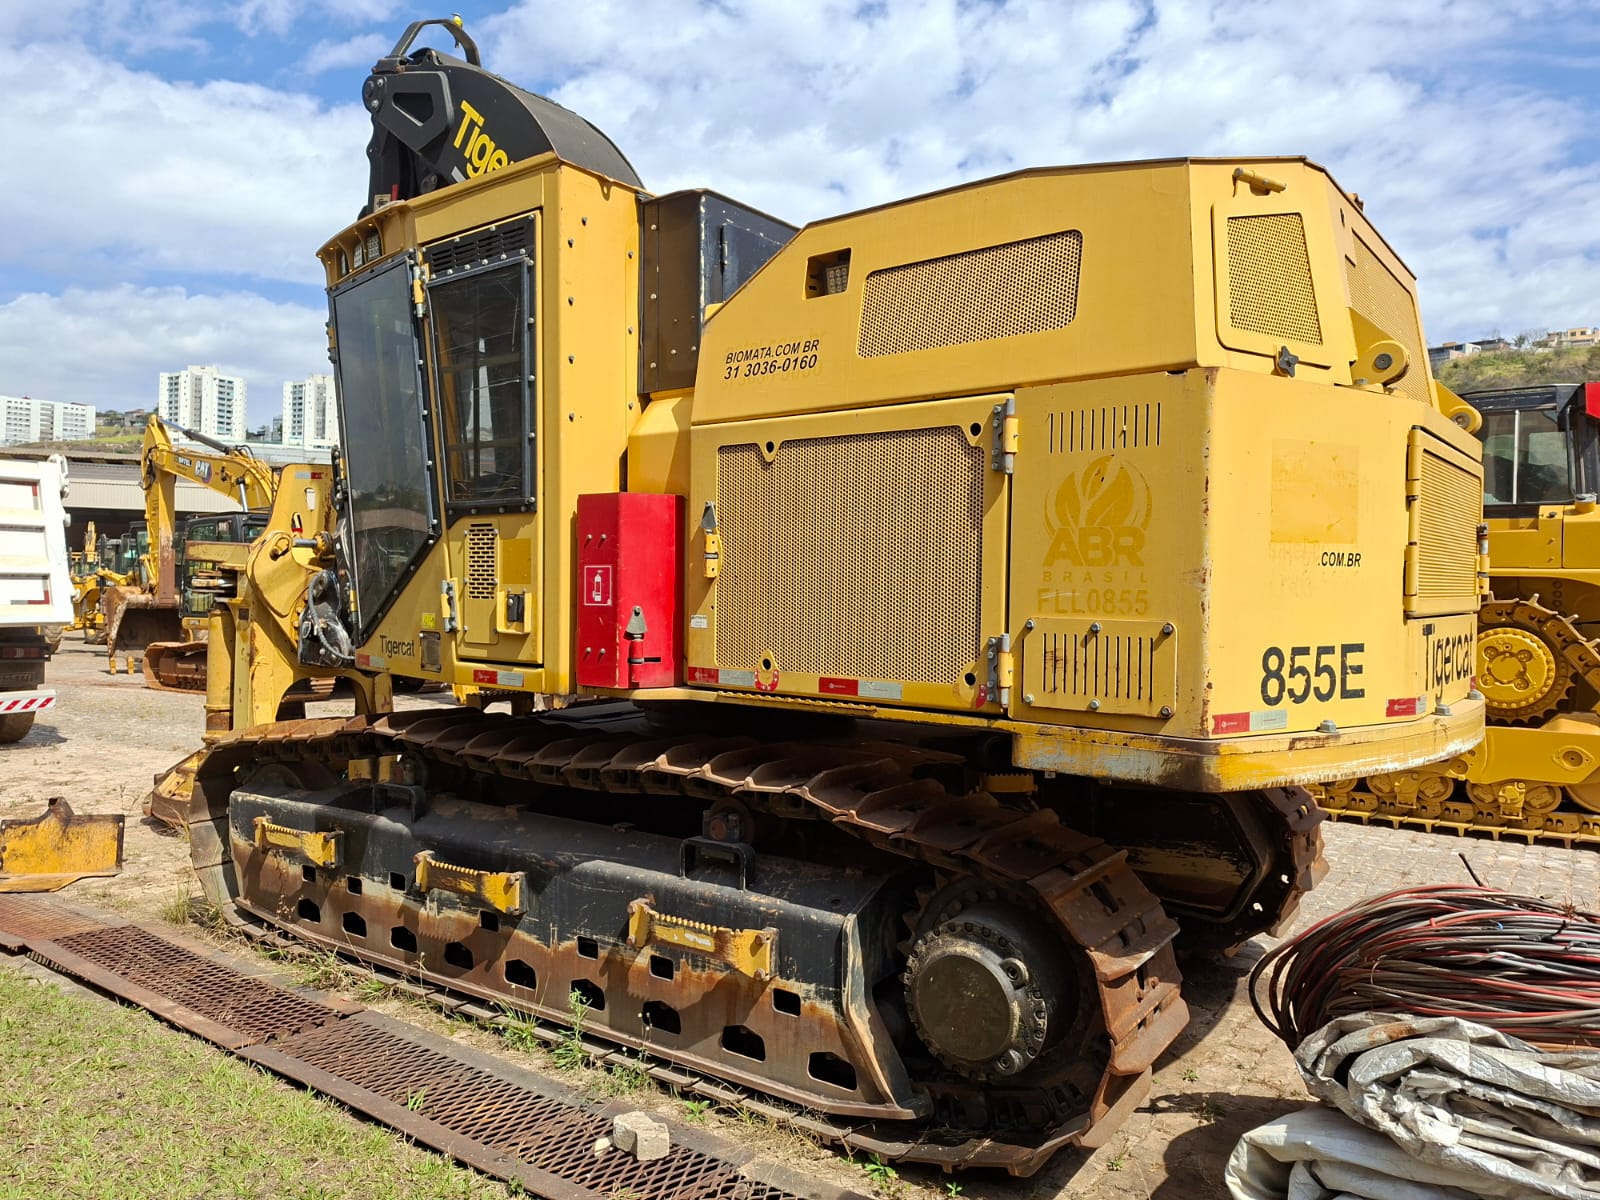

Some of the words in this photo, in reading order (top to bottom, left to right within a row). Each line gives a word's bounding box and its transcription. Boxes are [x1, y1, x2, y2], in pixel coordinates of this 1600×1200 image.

[453, 100, 515, 178] Tige
[725, 341, 801, 364] BIOMATA.COM
[802, 339, 819, 353] BR
[724, 365, 740, 380] 31
[744, 354, 818, 377] 3036-0160
[194, 459, 210, 478] CAT
[1042, 526, 1145, 567] ABR
[1318, 551, 1362, 567] .COM.BR
[1043, 571, 1147, 583] BRASIL
[1037, 588, 1149, 616] FLL0855
[380, 634, 415, 659] Tigercat
[1260, 643, 1365, 706] 855E
[1422, 622, 1473, 705] Tigercat
